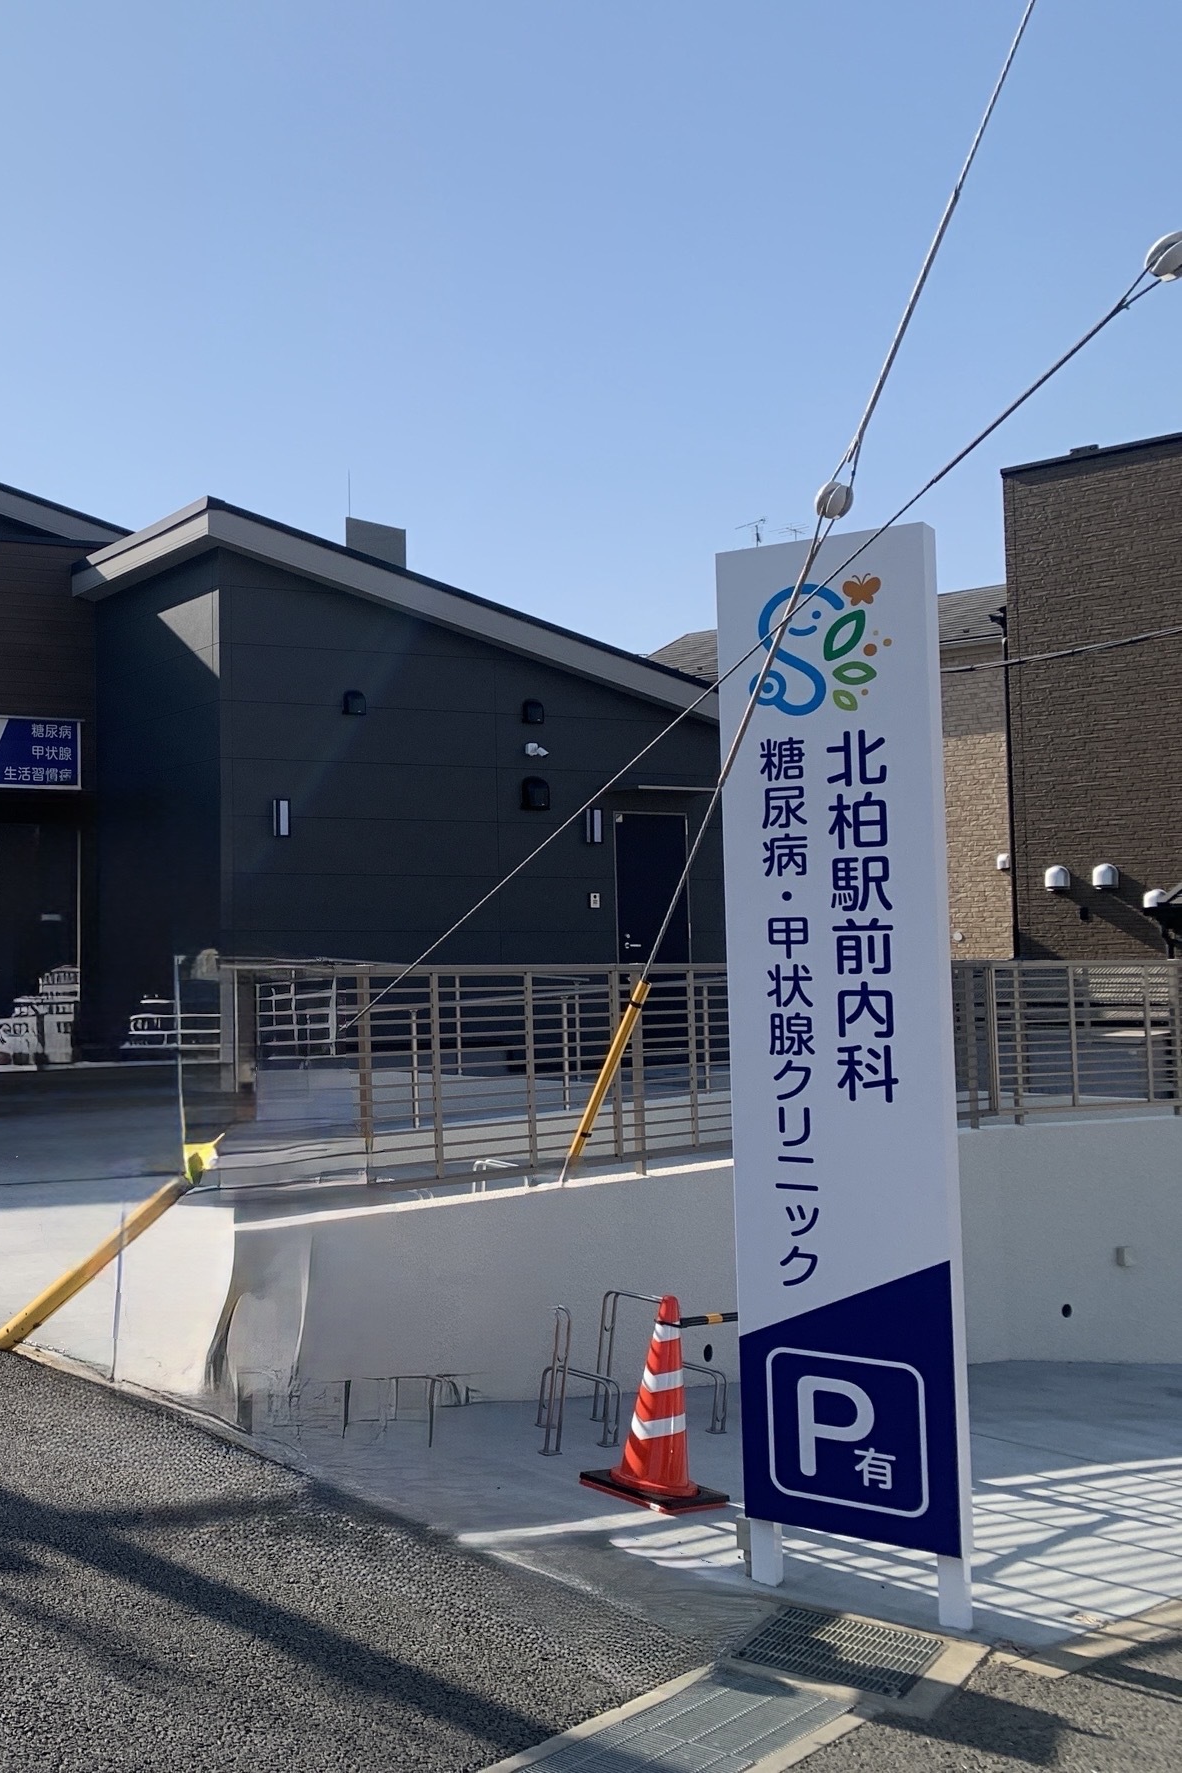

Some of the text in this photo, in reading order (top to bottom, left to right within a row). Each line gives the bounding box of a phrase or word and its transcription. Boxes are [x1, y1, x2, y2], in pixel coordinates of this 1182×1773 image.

[31, 723, 72, 739] 糖尿病
[31, 745, 72, 761] 甲状腺
[3, 766, 72, 782] 生活習慣病
[826, 728, 899, 1104] 北柏駅前内科
[759, 737, 819, 1287] 糖尿病・甲状腺クリニック
[796, 1374, 897, 1490] P 有
